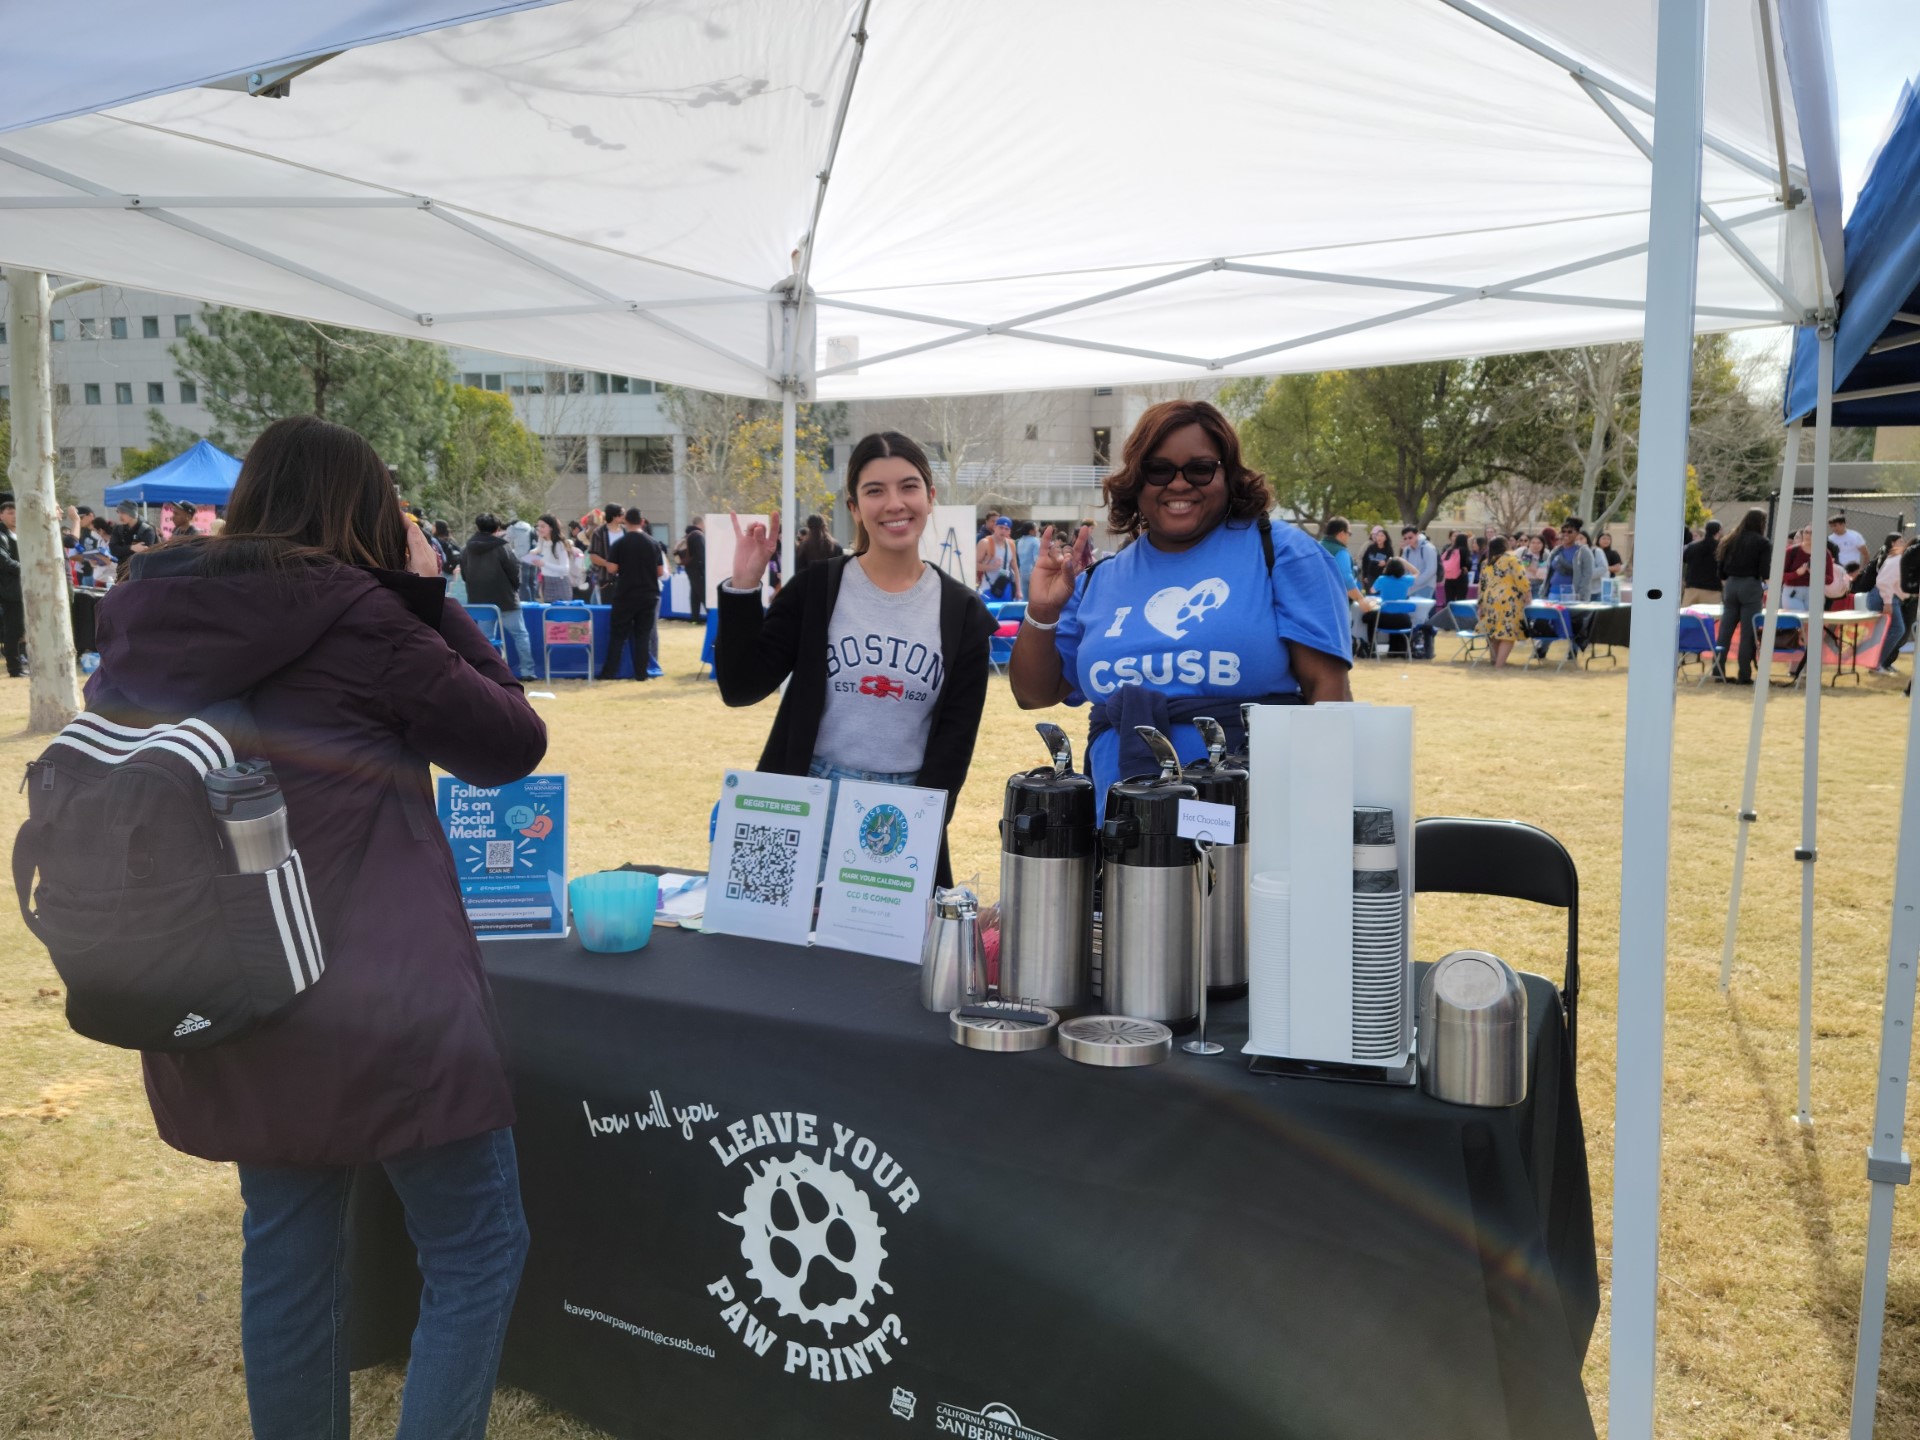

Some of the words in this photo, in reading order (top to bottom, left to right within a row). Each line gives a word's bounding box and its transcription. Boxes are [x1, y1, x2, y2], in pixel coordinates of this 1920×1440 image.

[1105, 607, 1132, 637] I
[827, 633, 945, 691] BOSTON
[1089, 649, 1241, 694] CSUSB
[834, 681, 858, 694] EST.
[904, 690, 927, 702] 1620
[450, 784, 501, 798] Follow
[450, 799, 469, 811] Us
[471, 802, 491, 811] on
[743, 798, 780, 810] REGISTER
[781, 803, 801, 812] HERE
[450, 811, 495, 825] Social
[860, 806, 881, 836] CSUSB
[887, 805, 908, 842] COYOTE
[1182, 812, 1195, 822] Hot
[1196, 814, 1231, 827] Chocolate
[449, 825, 496, 839] Media
[884, 852, 898, 864] DAY
[841, 872, 859, 880] MARK
[860, 874, 876, 883] YOUR
[876, 877, 912, 888] CALENDARS
[846, 890, 861, 899] CCD
[863, 892, 869, 900] IS
[870, 894, 901, 905] COMING!
[173, 1019, 212, 1037] adidas
[583, 1100, 630, 1138] how
[635, 1089, 672, 1131] will
[672, 1102, 720, 1141] you
[709, 1111, 819, 1167] LEAVE
[832, 1122, 921, 1214] YOUR
[564, 1299, 716, 1359] leaveyourpawprint@csusb.edu
[707, 1275, 778, 1357] PAW
[783, 1313, 908, 1382] PRINT?
[936, 1405, 987, 1427] CALIFORNIA
[988, 1420, 1013, 1436] STATE
[936, 1415, 966, 1437] SAN
[968, 1424, 1014, 1440] BERN
